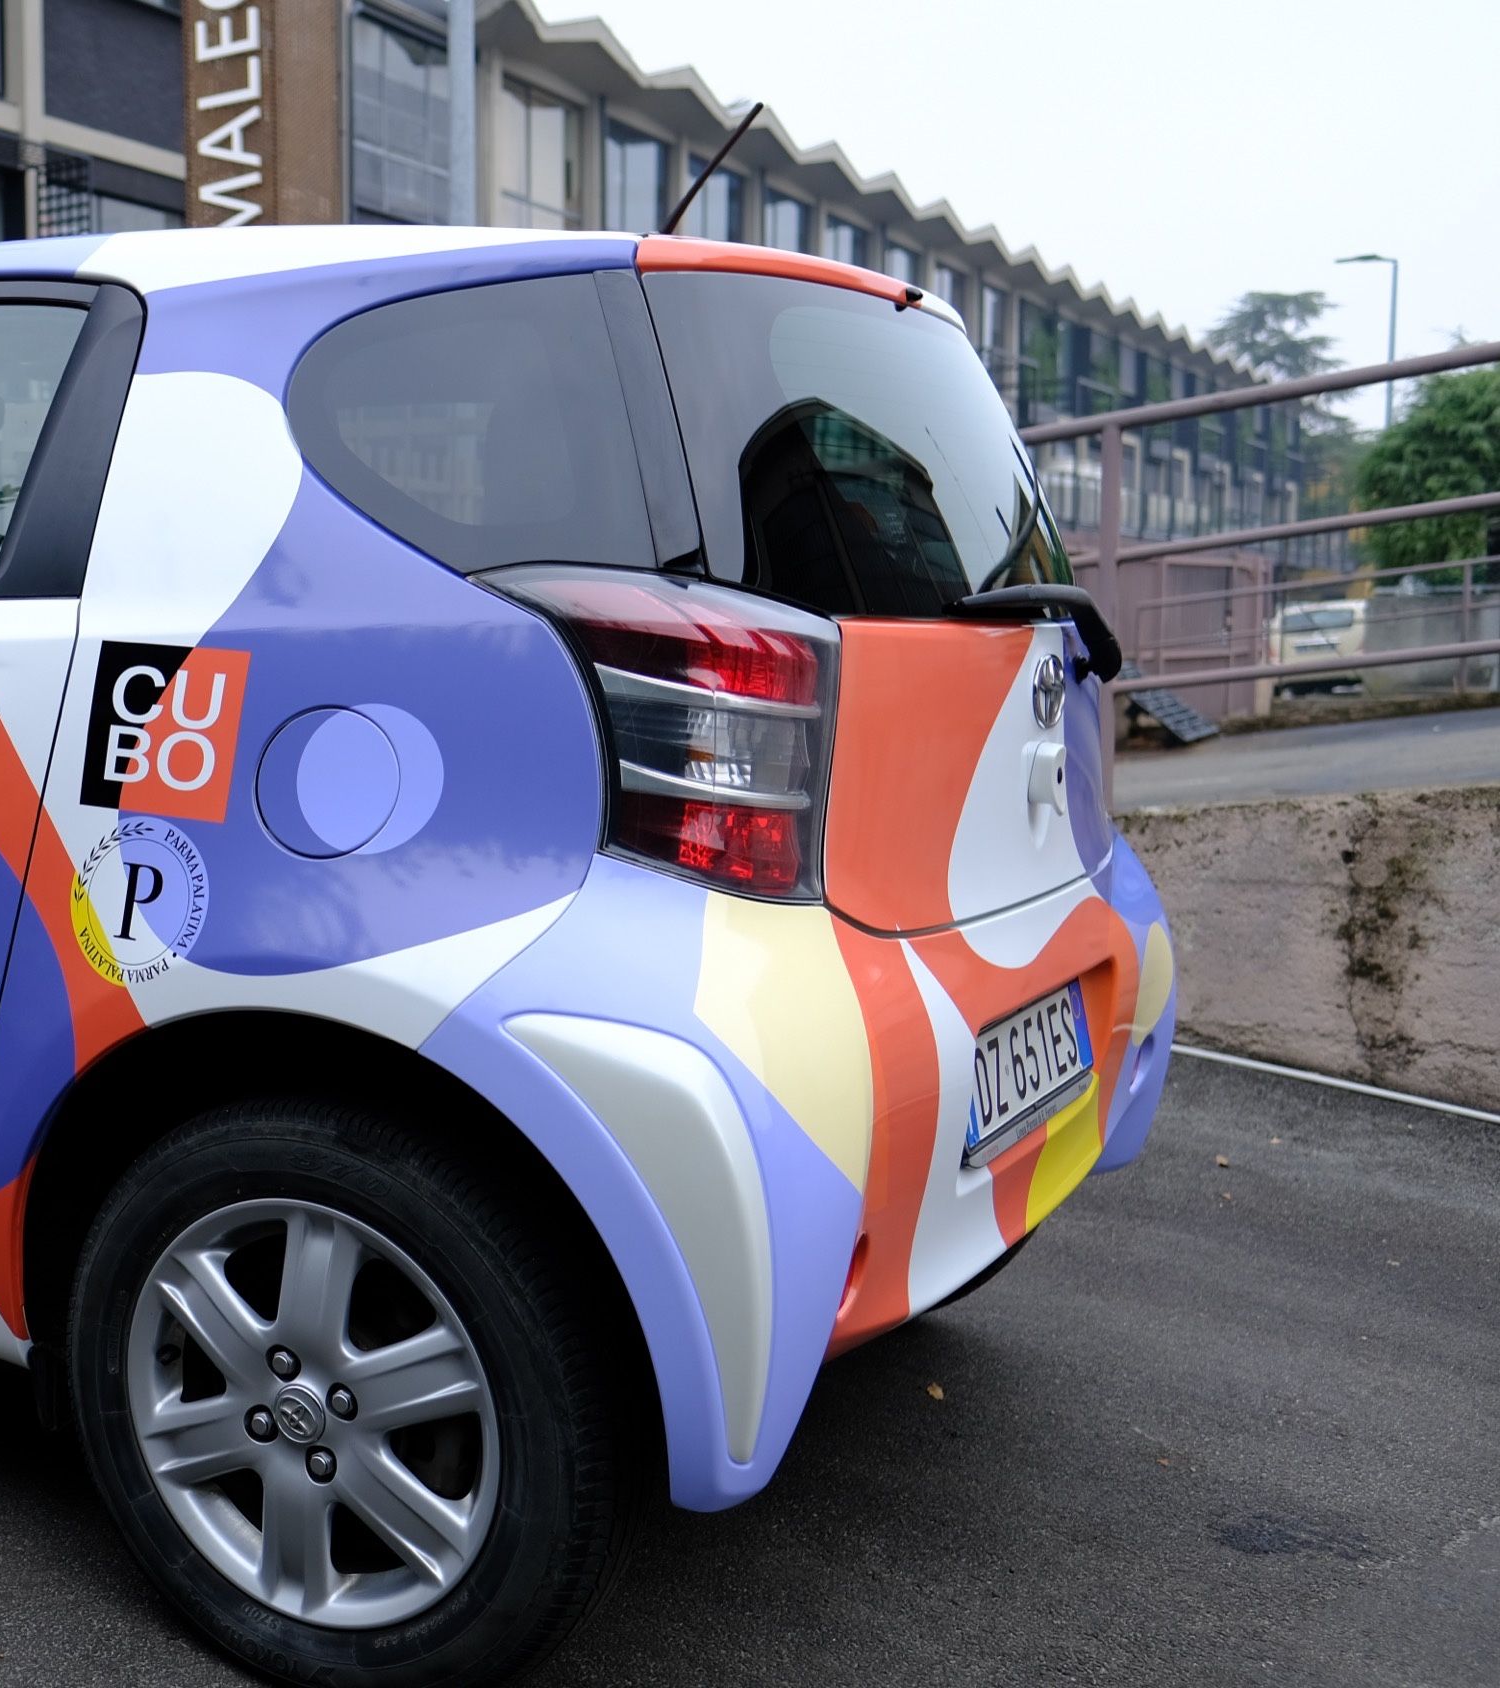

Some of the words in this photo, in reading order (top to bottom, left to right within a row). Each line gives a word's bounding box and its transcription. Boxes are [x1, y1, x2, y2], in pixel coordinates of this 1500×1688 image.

[194, 0, 264, 227] MALE
[163, 828, 199, 872] PARMA
[113, 861, 163, 941] P
[177, 872, 205, 949] PALATINA
[79, 927, 124, 982] PALATINA
[128, 958, 170, 983] PARMA
[974, 1037, 1010, 1127] DZ
[1009, 997, 1079, 1100] 651ES
